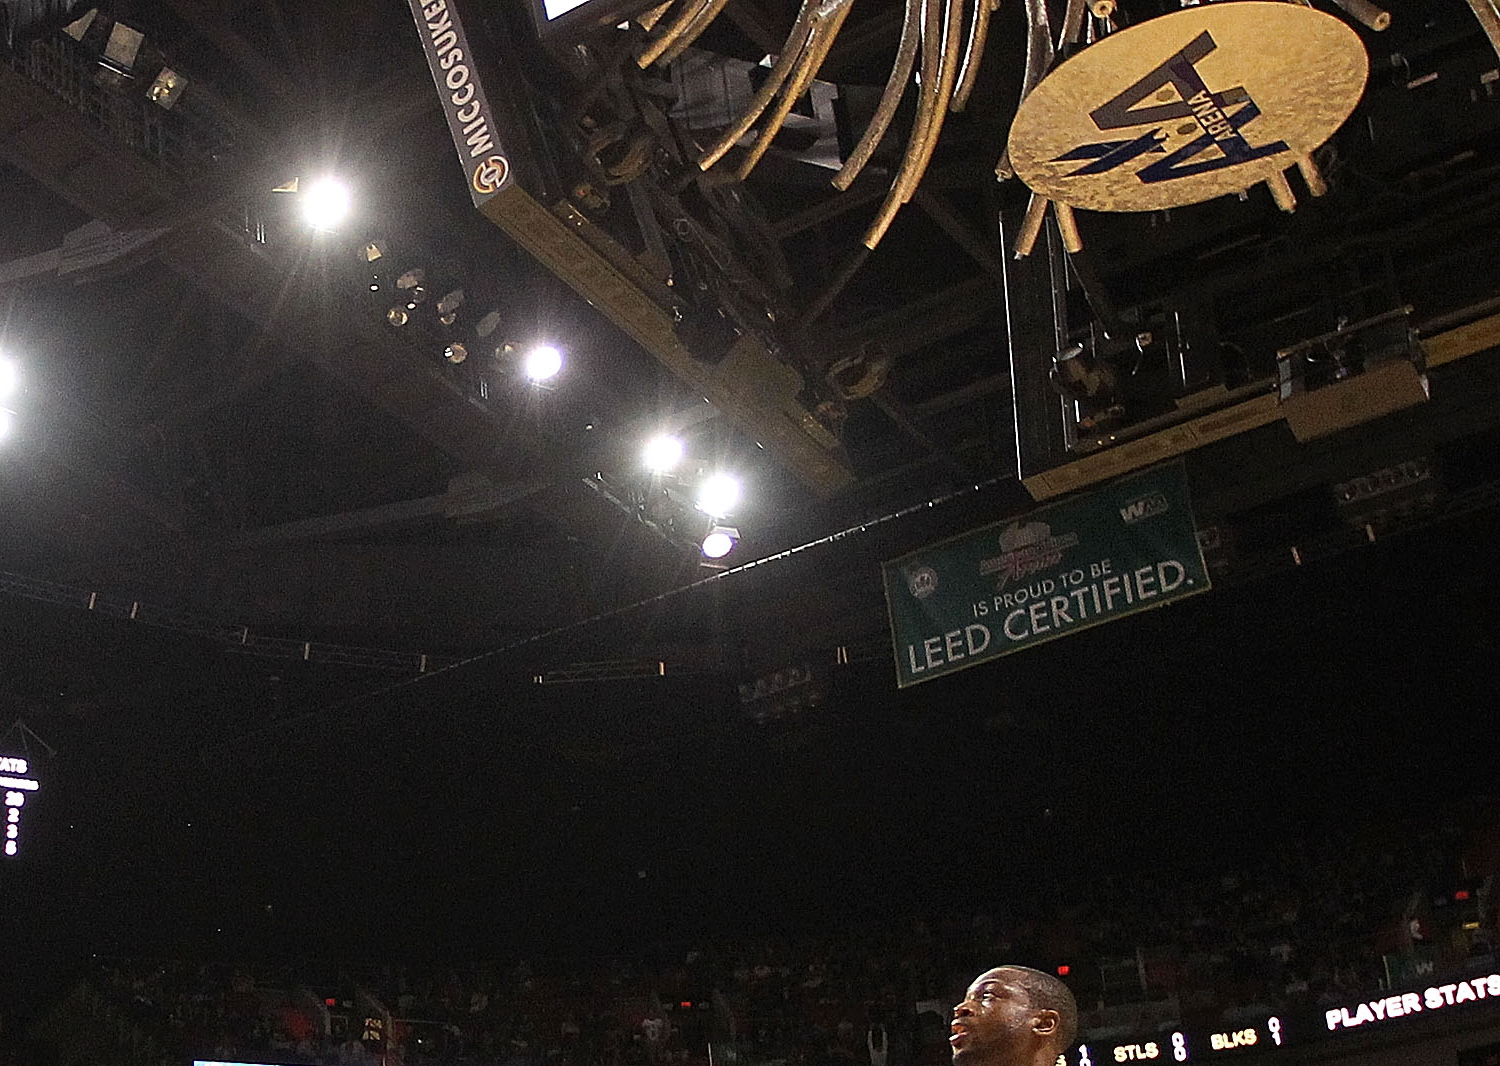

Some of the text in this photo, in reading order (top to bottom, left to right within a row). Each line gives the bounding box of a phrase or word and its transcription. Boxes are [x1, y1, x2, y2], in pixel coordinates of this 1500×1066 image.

[418, 0, 495, 158] MICCOSUKE
[1188, 90, 1238, 142] ARENA
[972, 558, 1113, 618] IS PROUD TO BE
[907, 624, 992, 674] LEED
[1002, 558, 1194, 642] CERTIFIED.
[1325, 973, 1500, 1031] PLAYER STATS
[1268, 1016, 1281, 1034] 0
[1171, 1031, 1185, 1048] 0
[1210, 1028, 1258, 1051] BLKS
[1271, 1031, 1282, 1046] 1
[1078, 1044, 1089, 1059] 1
[1113, 1042, 1159, 1063] STLS
[1173, 1046, 1187, 1062] 0
